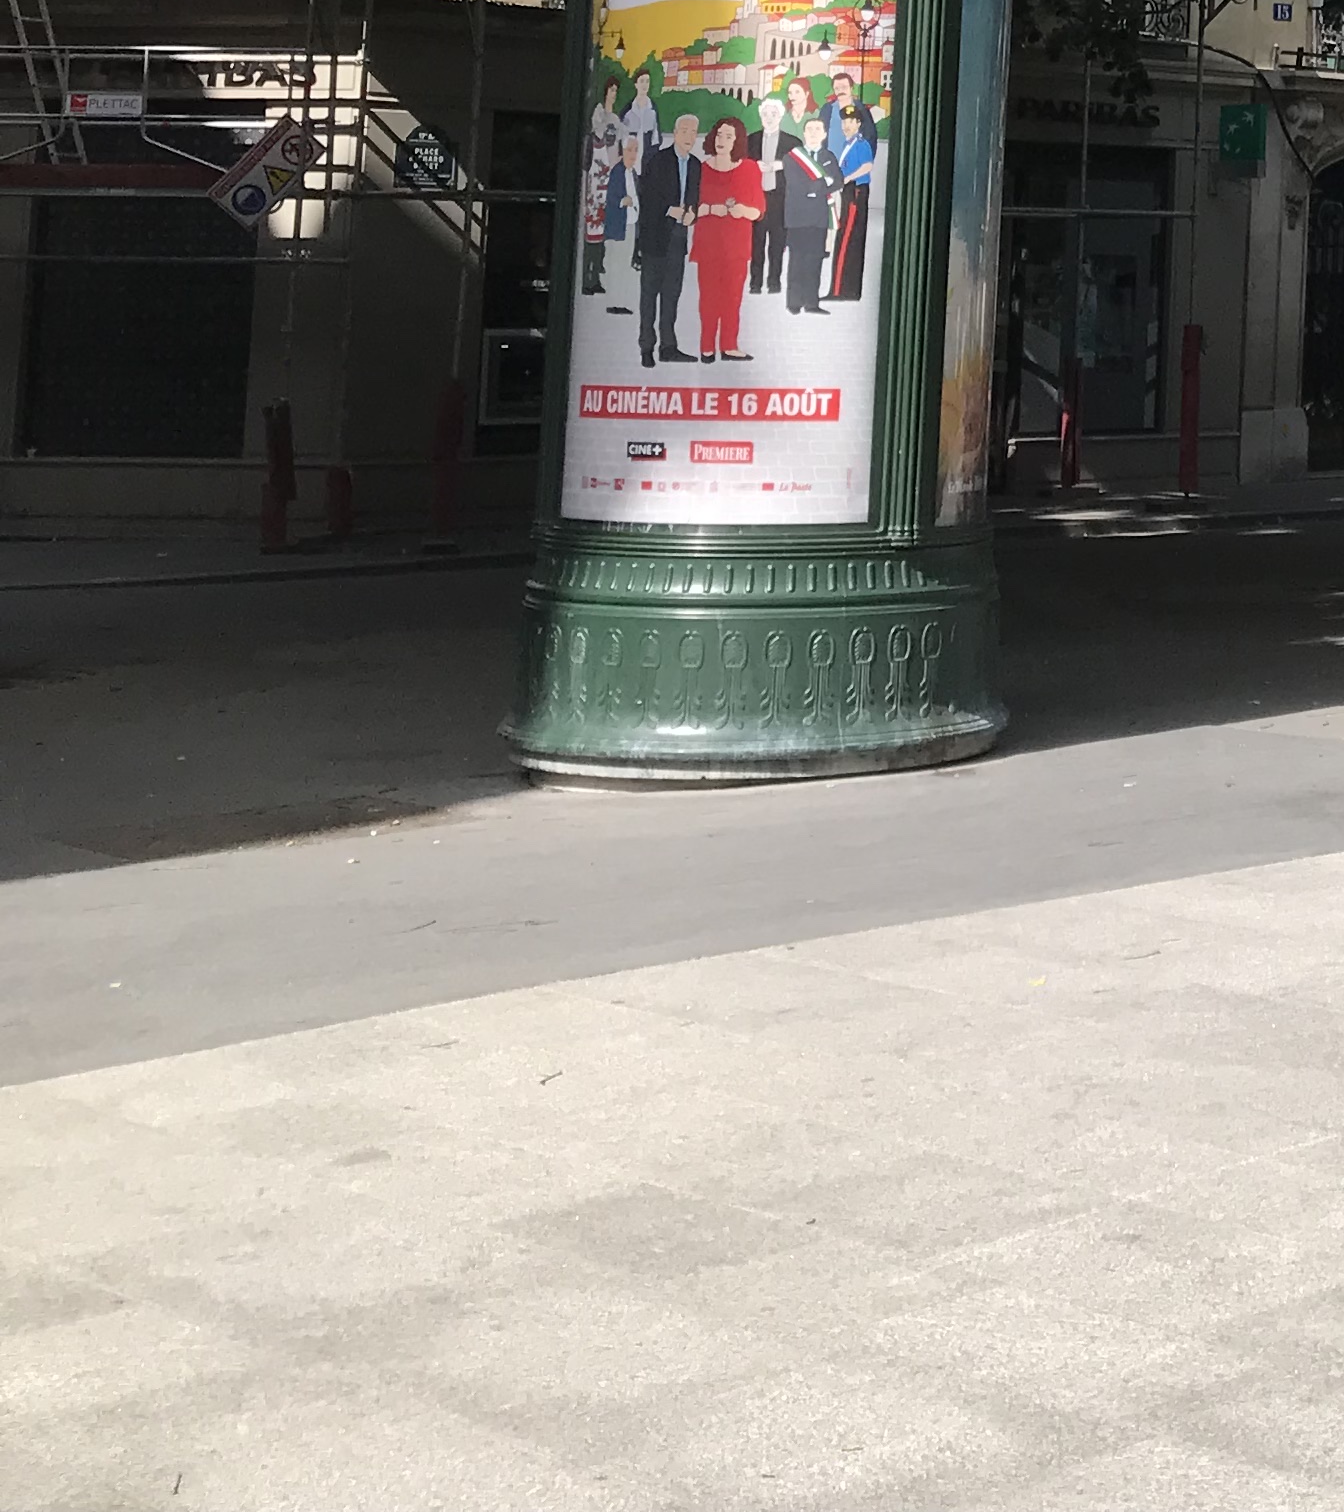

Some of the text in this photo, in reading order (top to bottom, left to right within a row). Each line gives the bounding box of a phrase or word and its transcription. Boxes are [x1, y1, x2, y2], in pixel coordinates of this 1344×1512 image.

[1277, 4, 1290, 19] 15
[88, 98, 139, 110] PLETTAC
[583, 386, 832, 417] AU CINÉMA LE 16 AOÛT
[693, 444, 750, 461] PREMIERE
